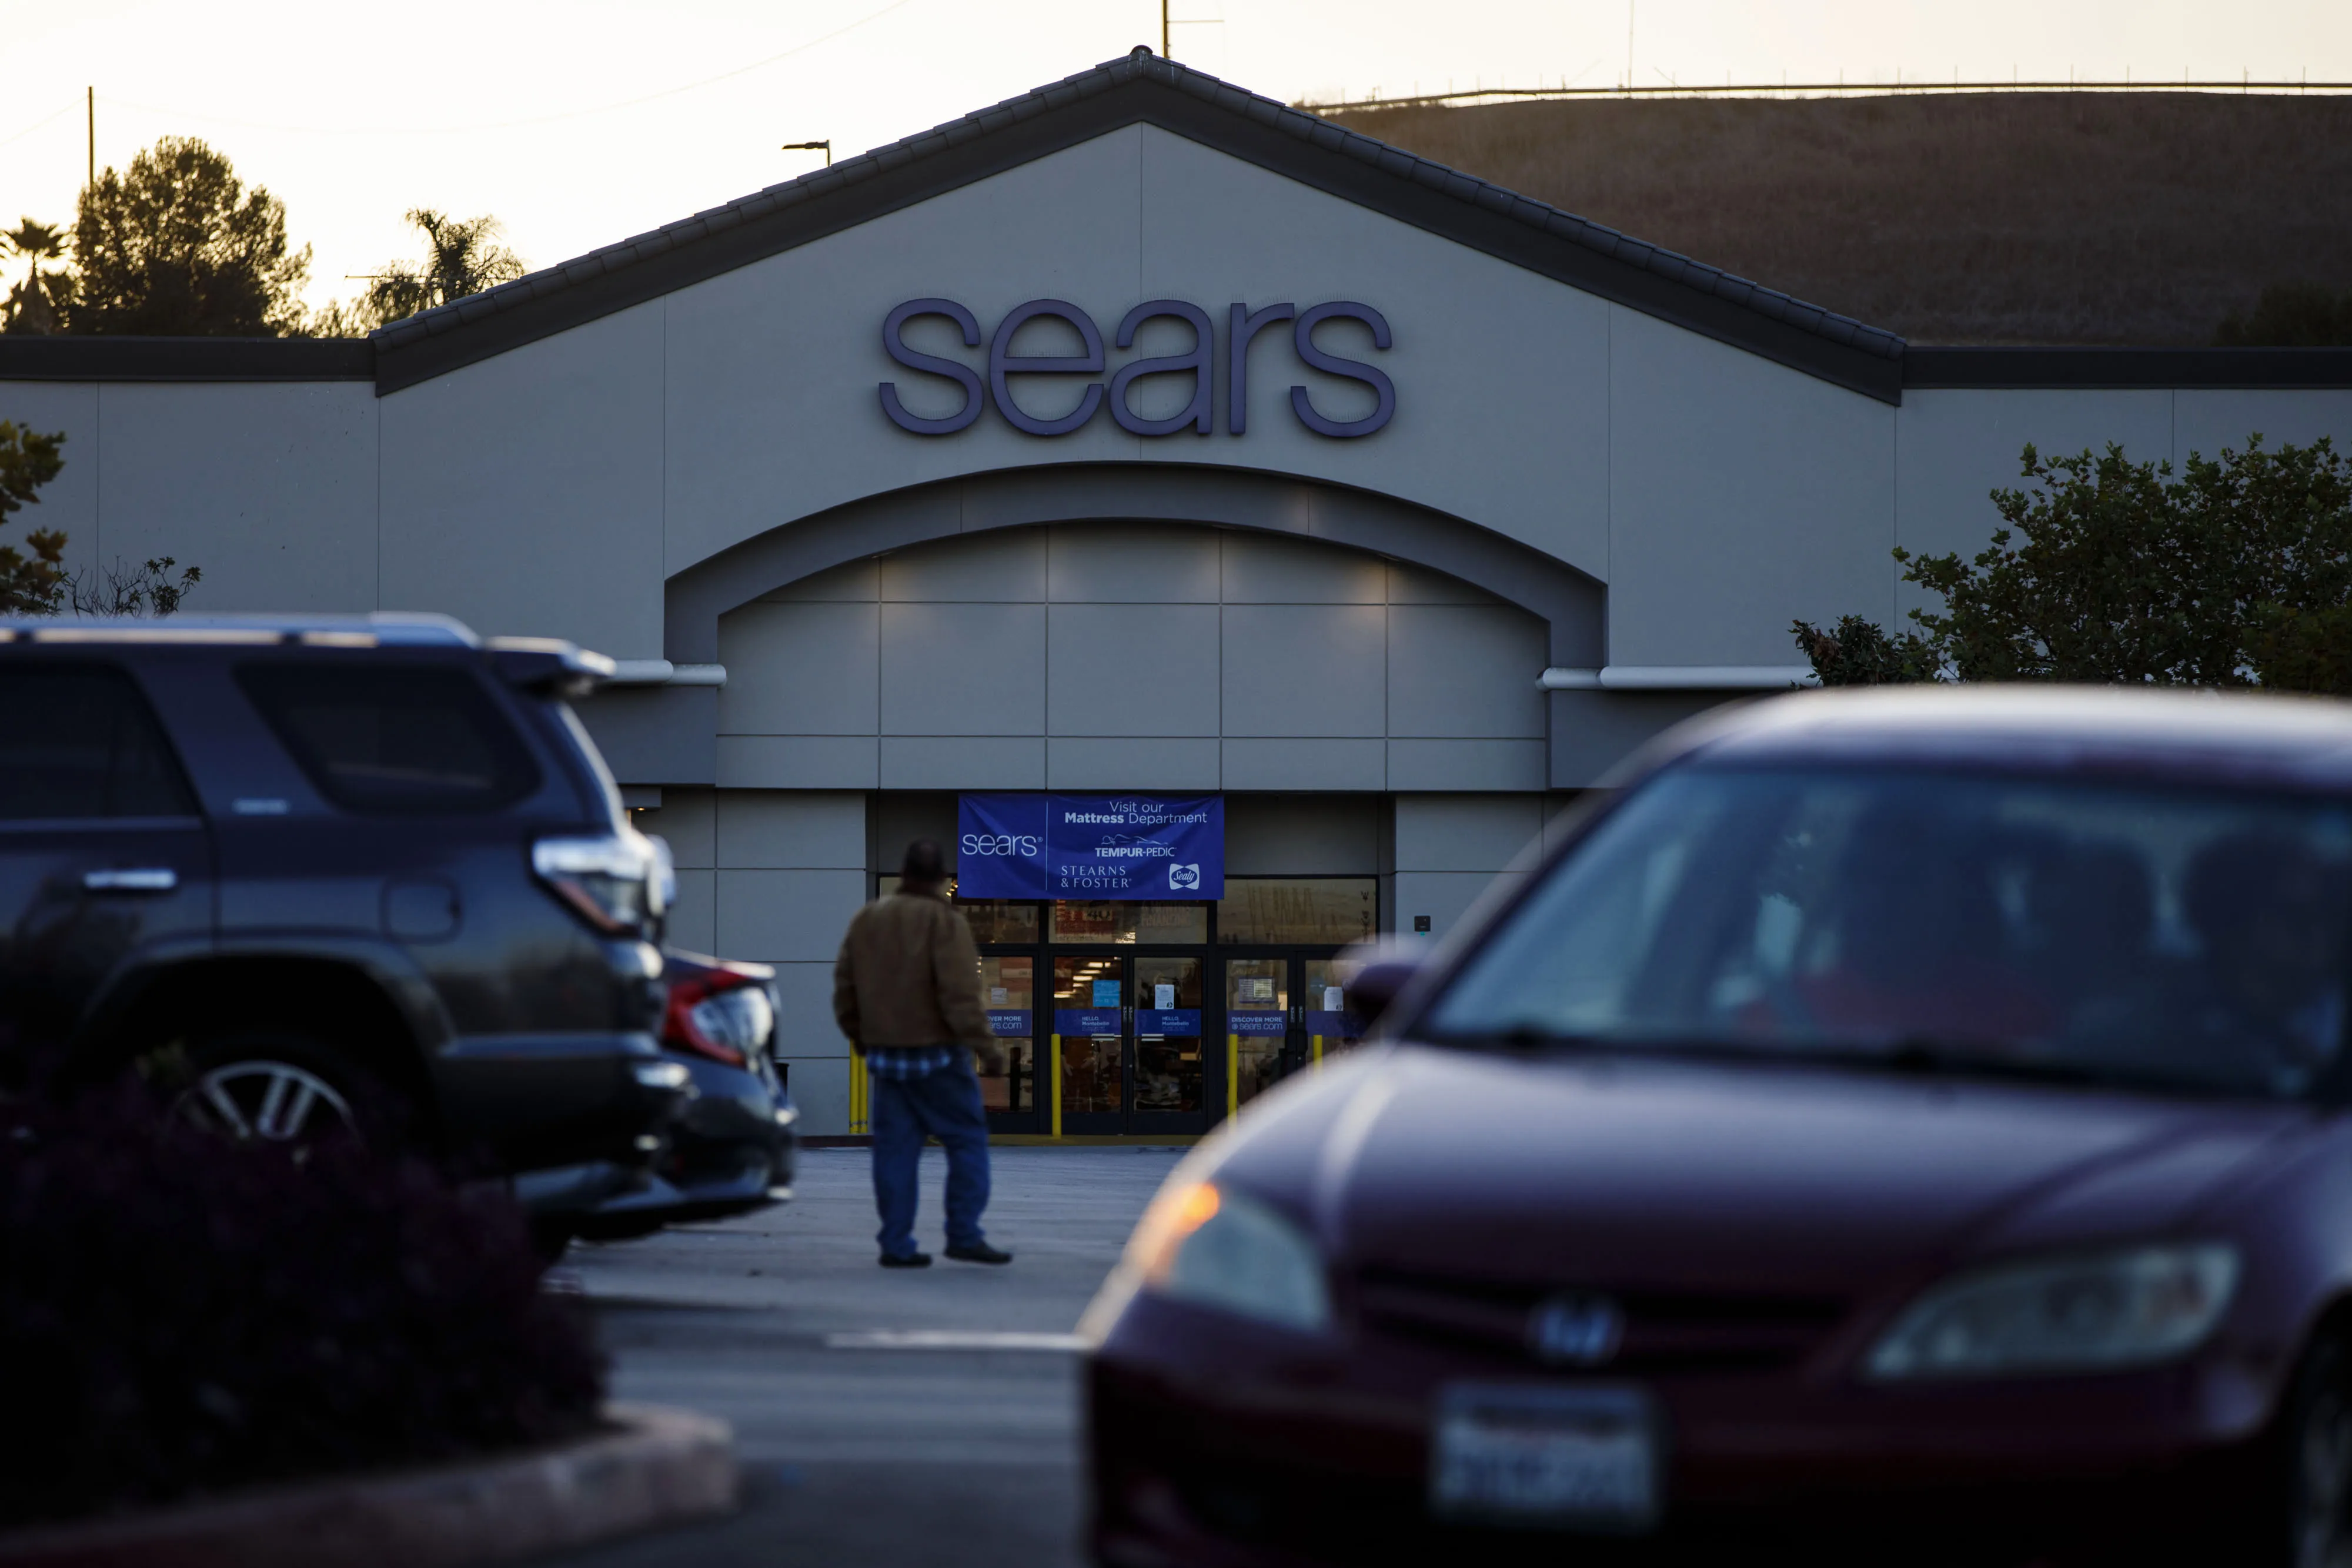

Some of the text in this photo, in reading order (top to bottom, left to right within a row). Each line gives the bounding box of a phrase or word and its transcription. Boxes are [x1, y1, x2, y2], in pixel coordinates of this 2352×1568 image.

[878, 297, 1396, 438] sears
[1110, 801, 1164, 813] Visit our
[1065, 812, 1207, 825] Mattress Department
[1095, 847, 1175, 857] TEMPUR-PEDIC
[1061, 865, 1126, 875] STEARNS
[1173, 870, 1195, 883] Sealy
[1061, 878, 1129, 888] & FOSTER
